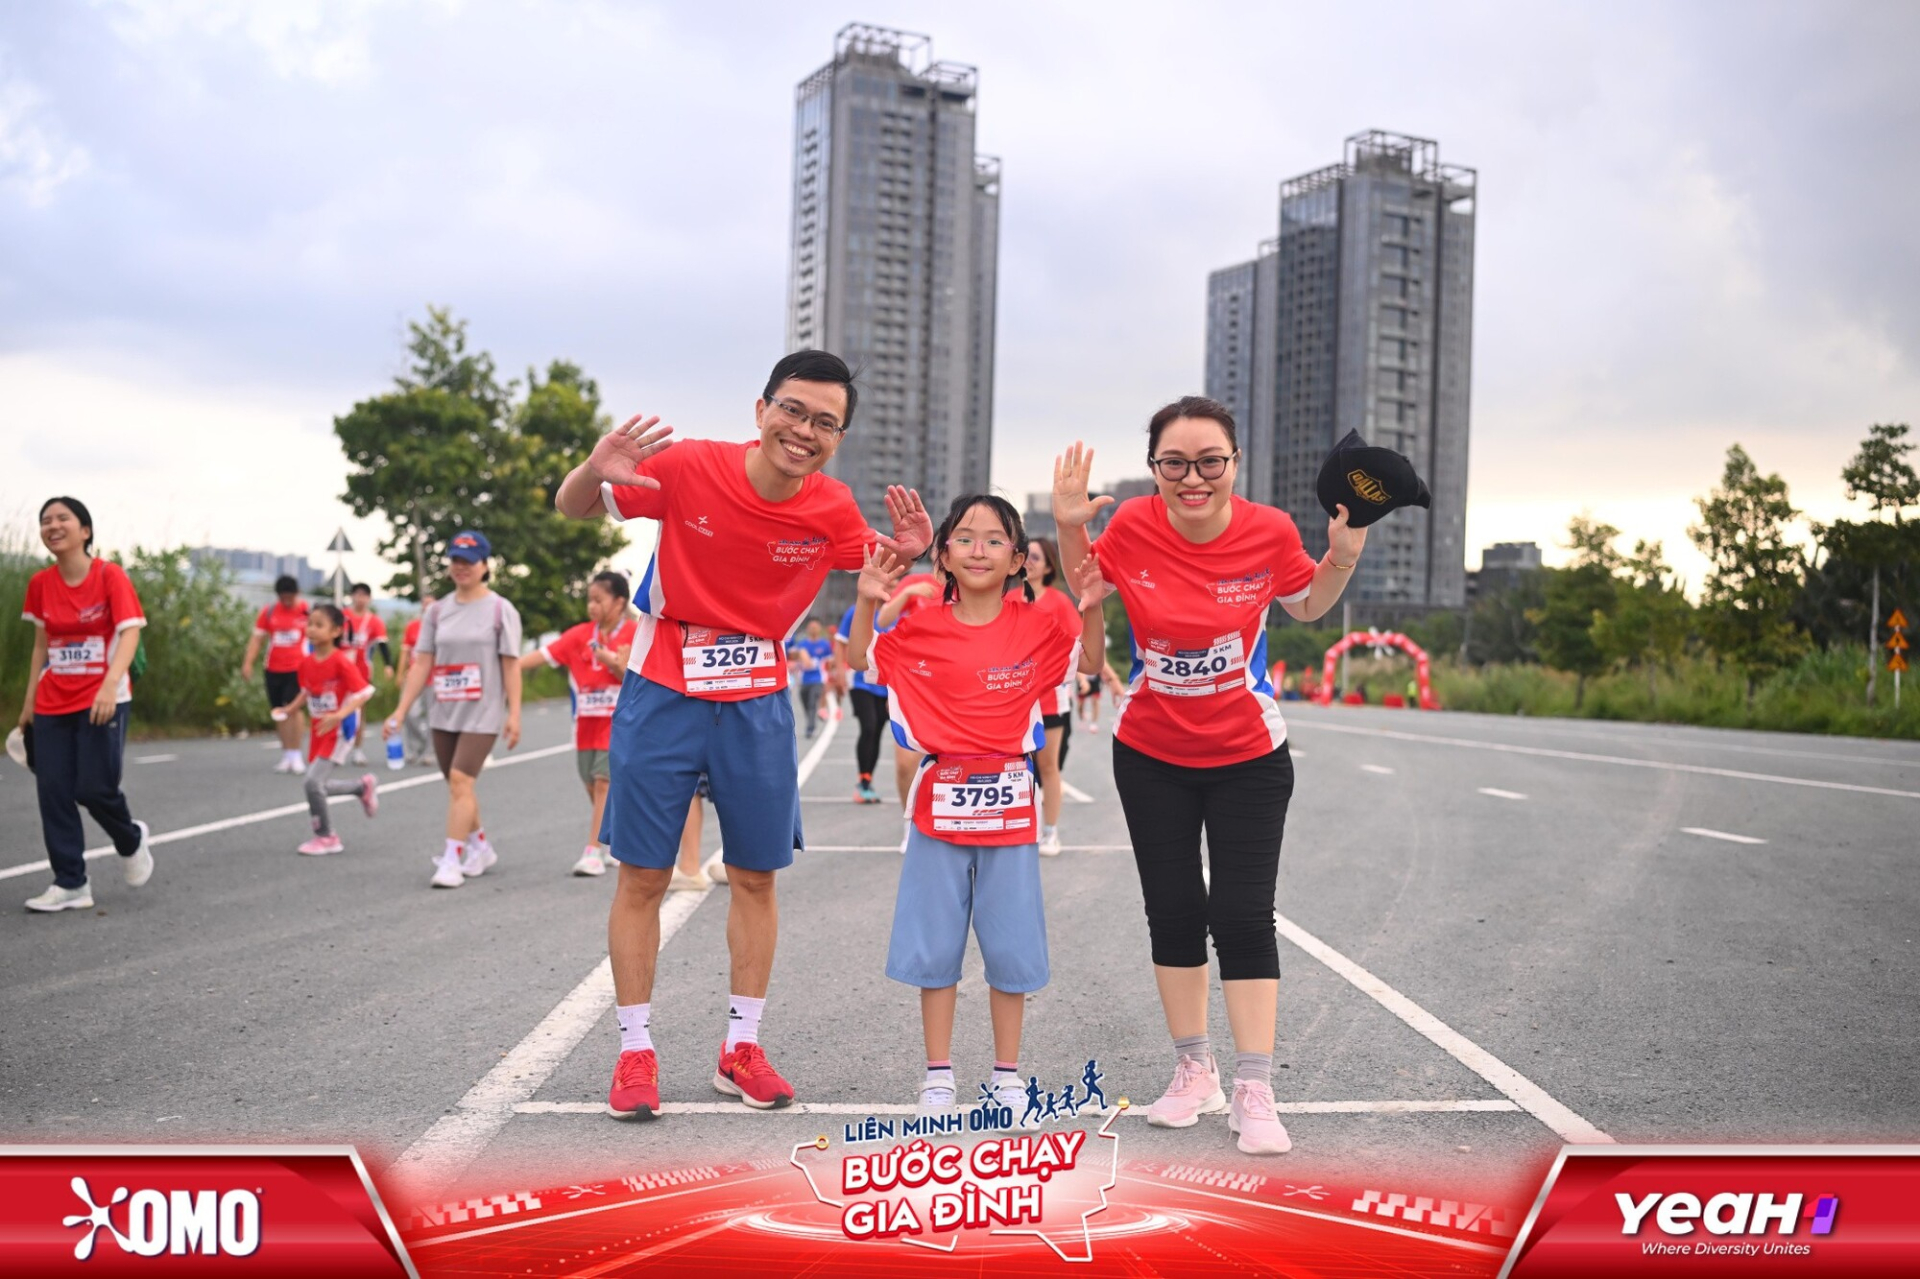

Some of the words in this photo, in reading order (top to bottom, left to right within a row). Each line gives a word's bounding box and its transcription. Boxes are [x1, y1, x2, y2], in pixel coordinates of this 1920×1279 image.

[702, 646, 759, 667] 3267
[1219, 644, 1232, 652] KM
[1160, 656, 1227, 677] 2840
[951, 786, 1014, 807] 3795
